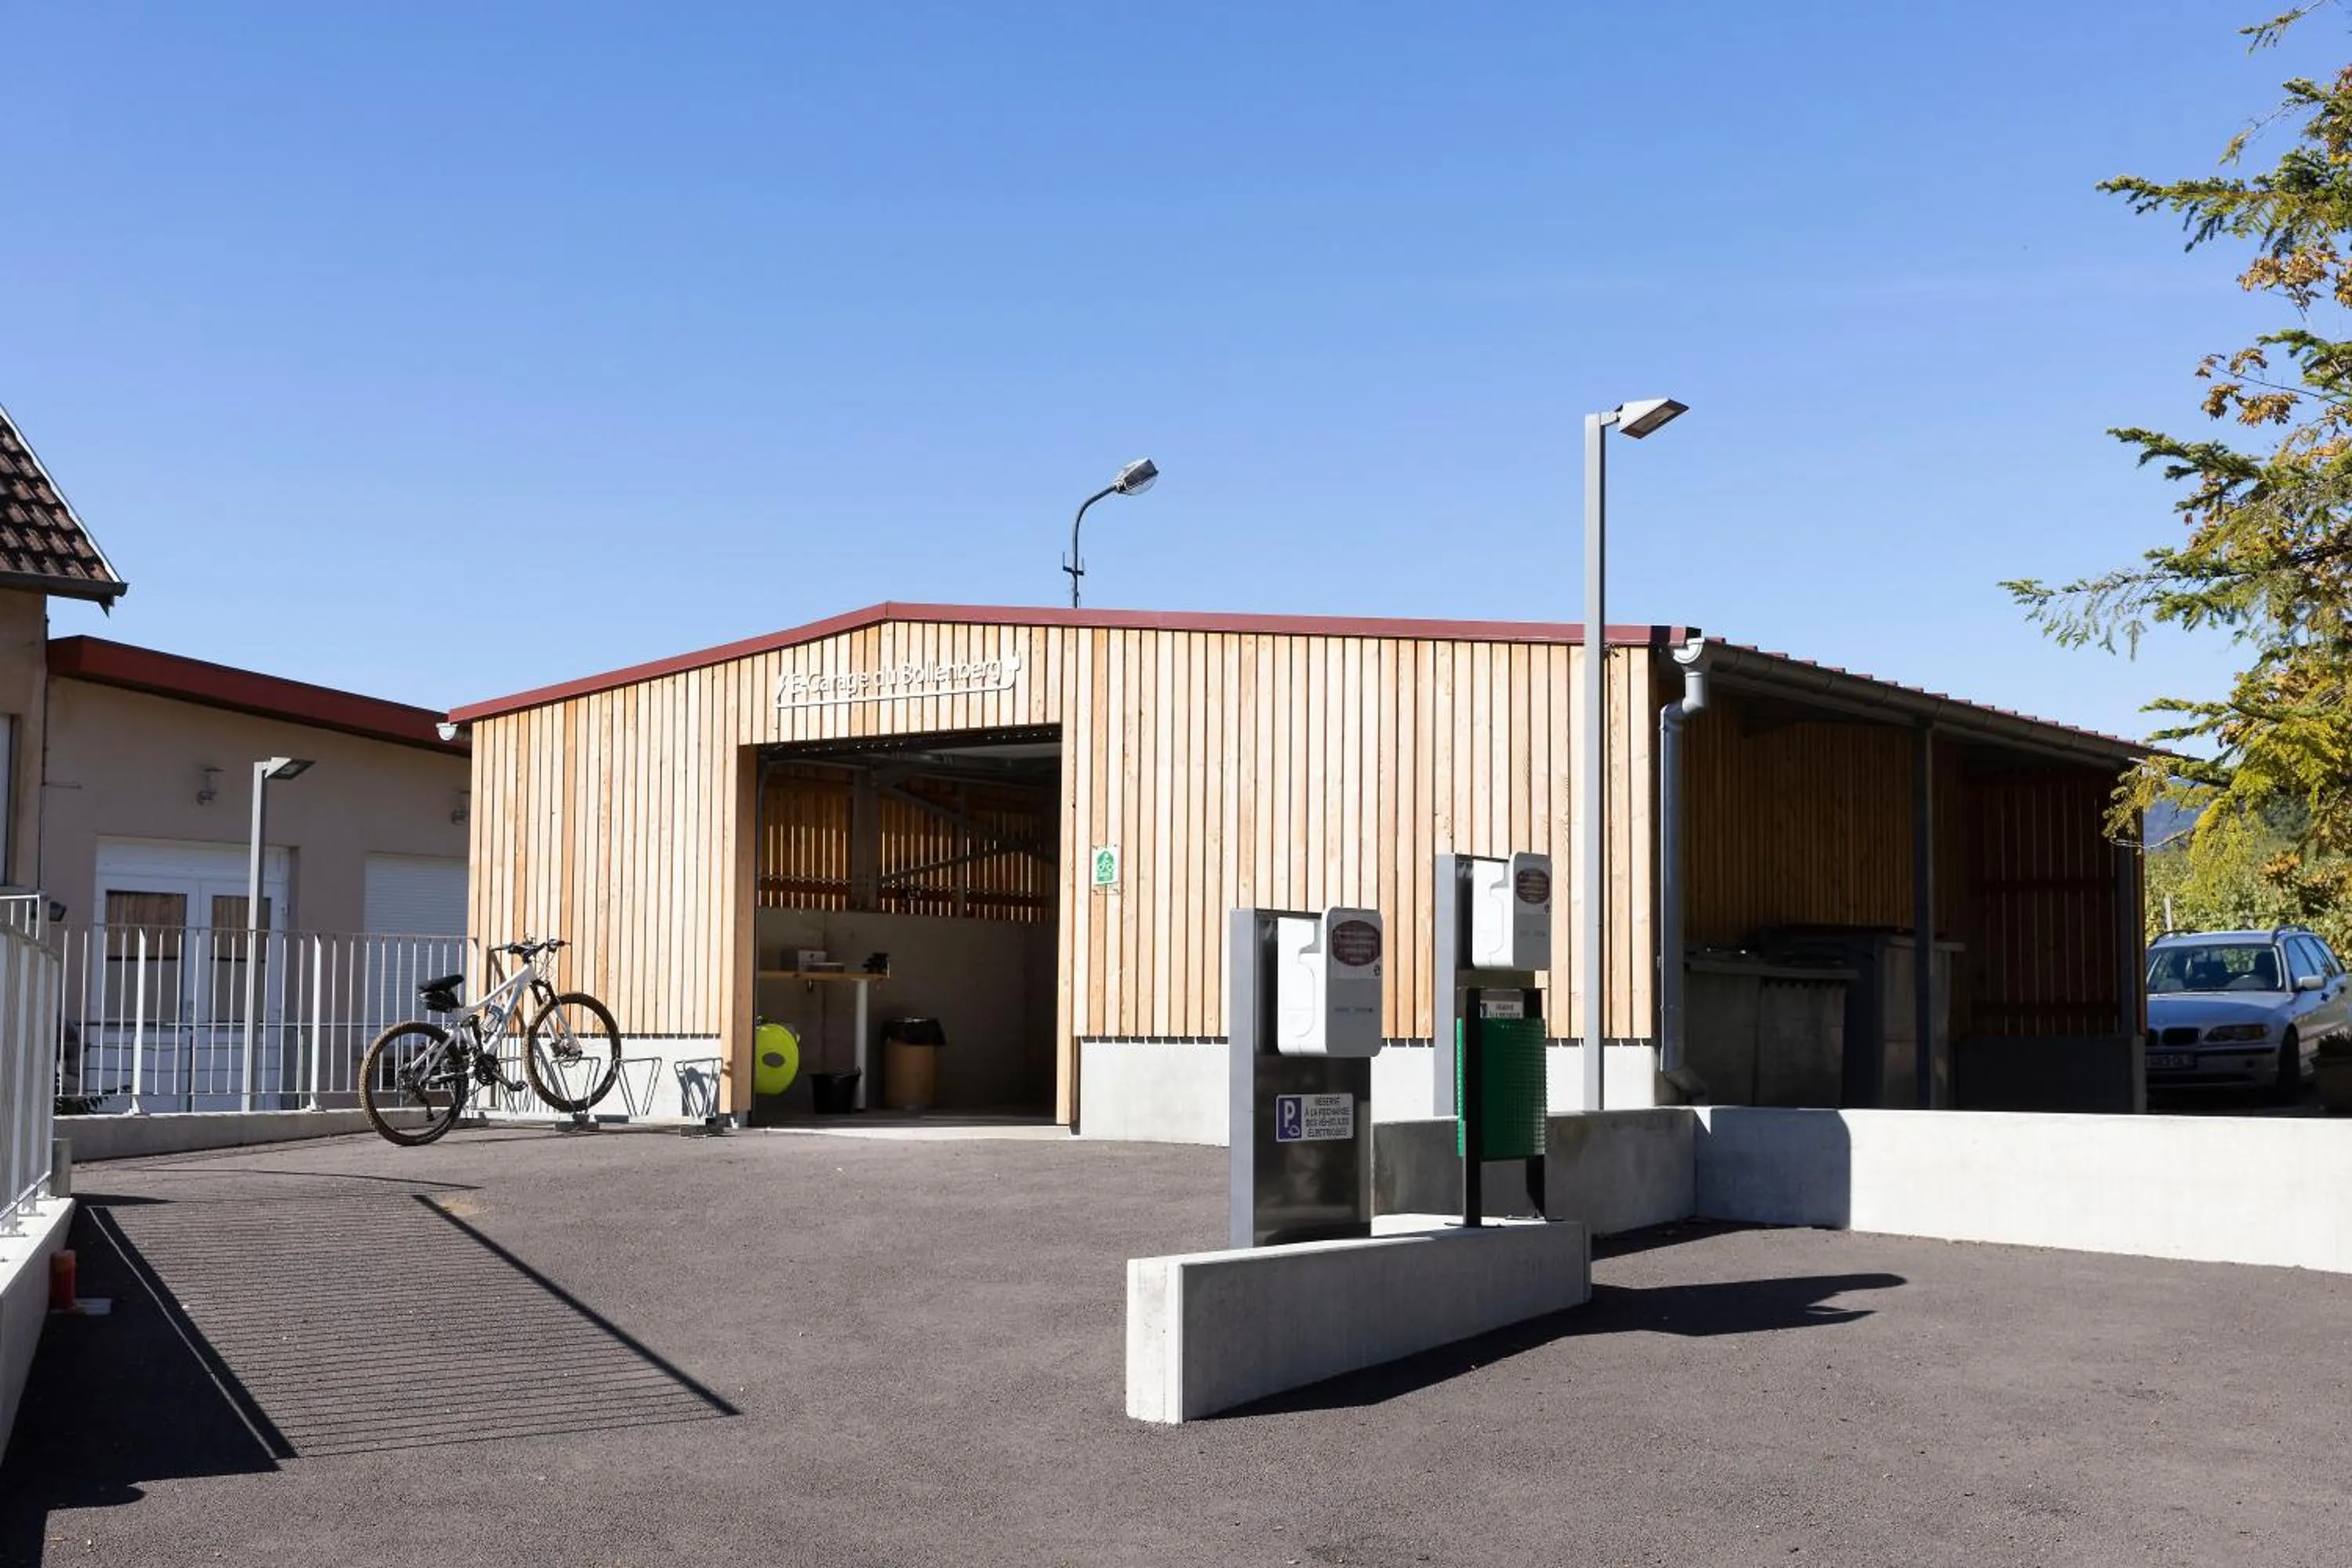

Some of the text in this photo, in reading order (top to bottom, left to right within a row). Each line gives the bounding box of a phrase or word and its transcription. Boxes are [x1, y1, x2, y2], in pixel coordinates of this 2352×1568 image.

[874, 665, 898, 687] du
[902, 657, 1003, 684] Bollenberg
[1284, 1100, 1295, 1127] P
